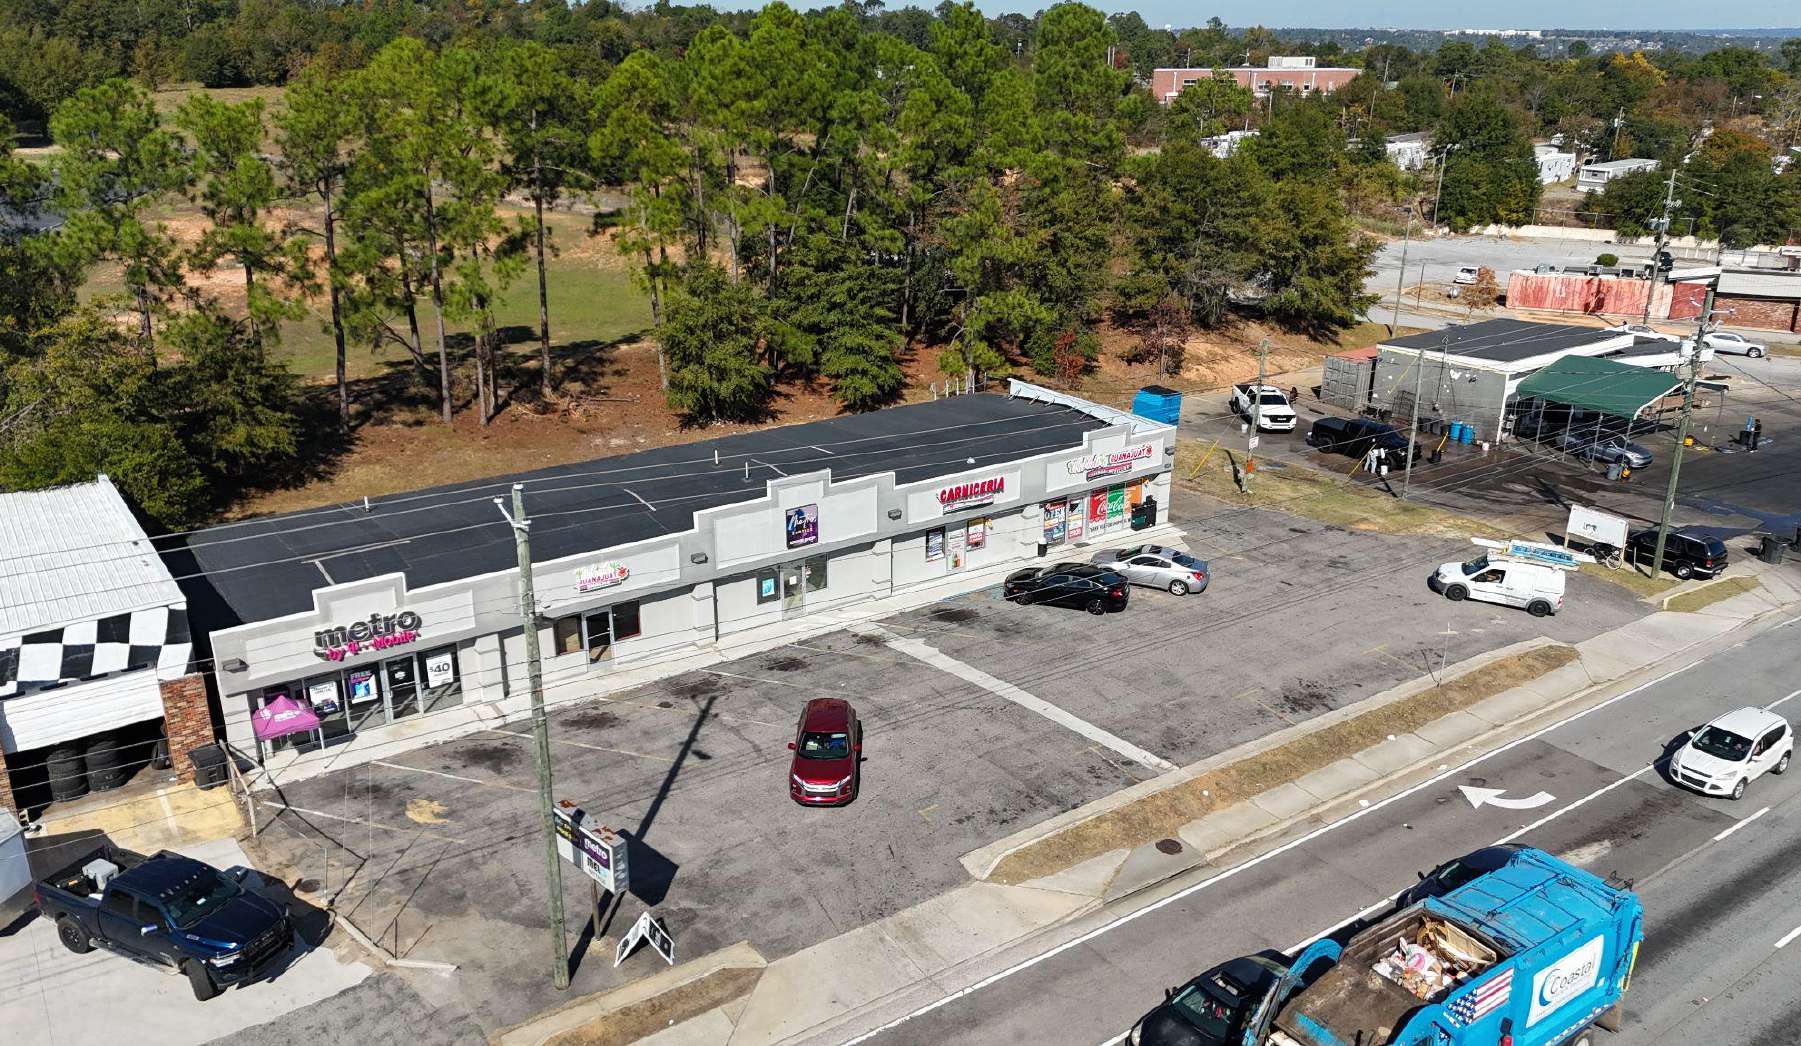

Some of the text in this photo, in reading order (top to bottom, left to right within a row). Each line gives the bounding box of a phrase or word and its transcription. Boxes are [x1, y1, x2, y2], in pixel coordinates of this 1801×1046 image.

[940, 476, 1004, 503] CARNICERIA
[314, 610, 422, 648] metro
[584, 838, 608, 860] metro
[1551, 952, 1597, 995] Coastal
